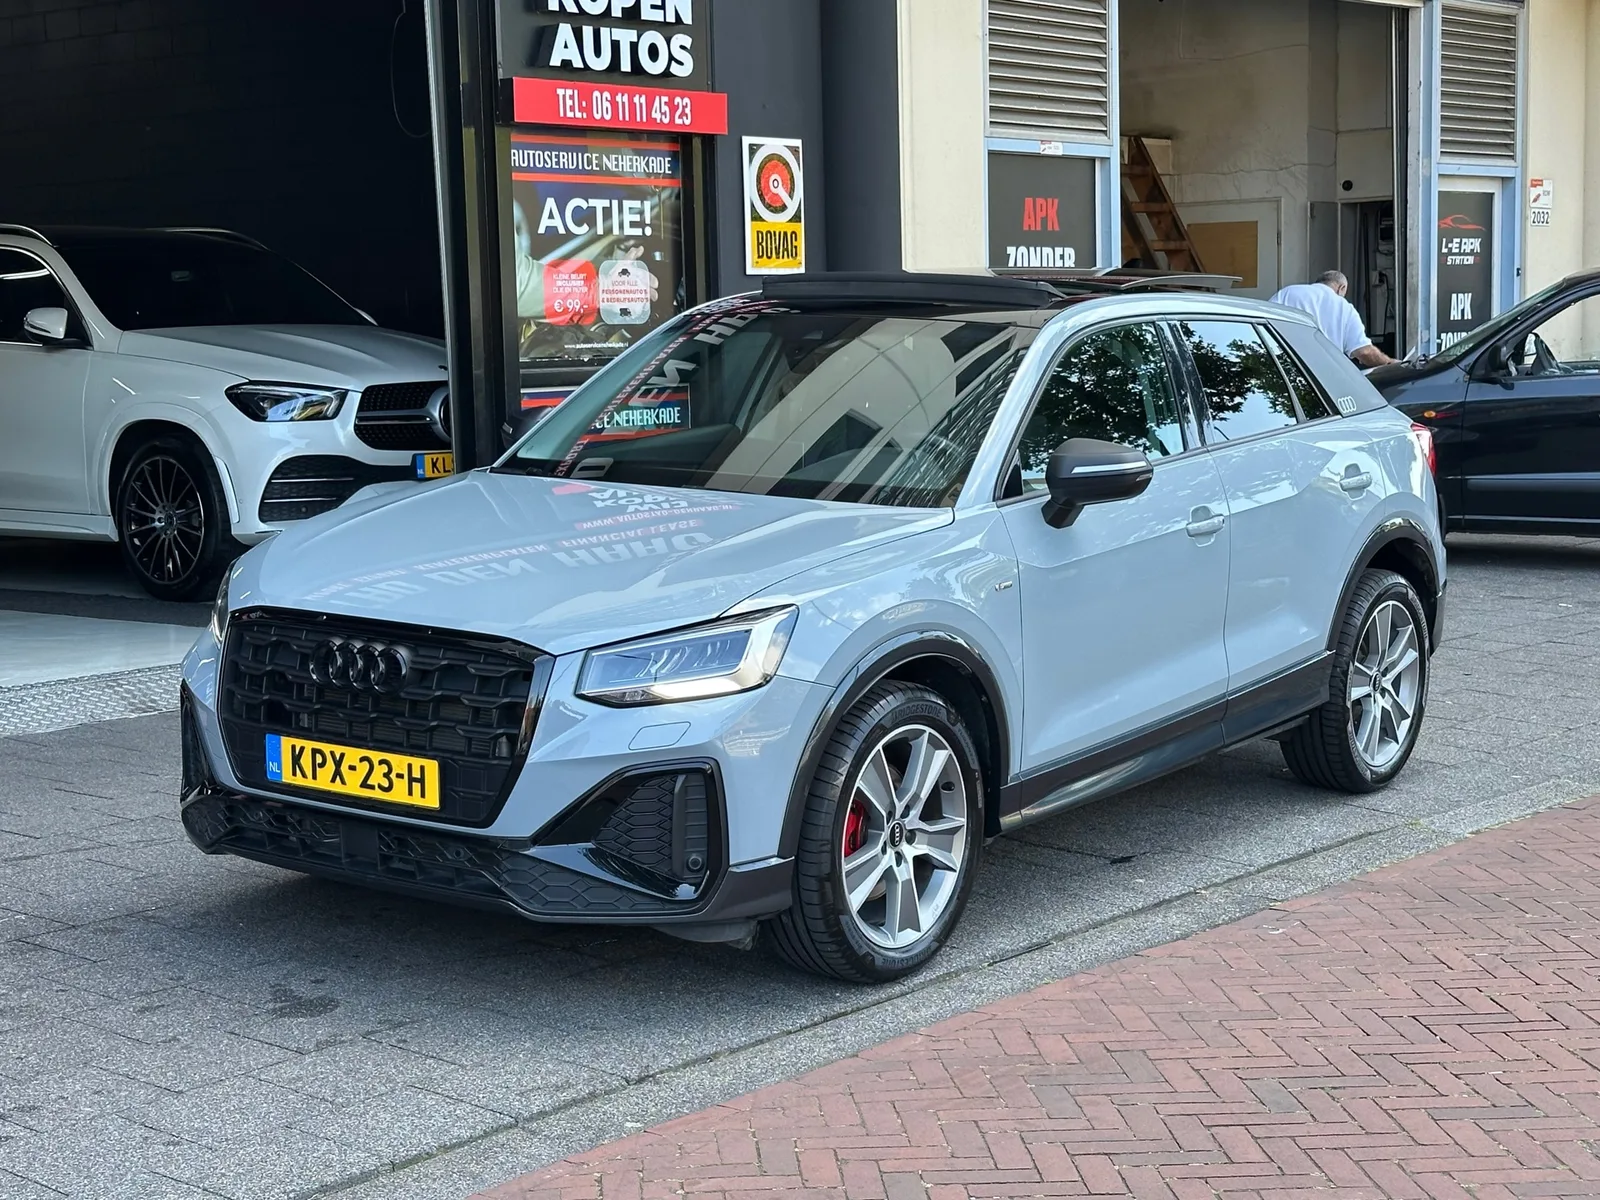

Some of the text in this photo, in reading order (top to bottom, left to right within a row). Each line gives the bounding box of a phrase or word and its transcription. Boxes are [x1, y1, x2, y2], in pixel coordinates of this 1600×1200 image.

[549, 23, 694, 77] AUTOS
[556, 88, 692, 125] TEL: 06 11 11 45 23
[511, 150, 672, 174] AUTOSERVICE NEHERKADE
[537, 197, 652, 237] ACTIE!
[1022, 197, 1060, 231] APK
[1531, 211, 1550, 224] 2032
[756, 230, 798, 260] BOVAG
[1006, 246, 1076, 268] ZONDER
[1461, 238, 1481, 253] APK
[1446, 255, 1474, 265] STATION
[554, 300, 563, 312] €
[1450, 293, 1472, 320] APK
[613, 407, 681, 428] NEHERKADE
[431, 456, 454, 474] KL
[269, 744, 427, 799] NL KPX-23-H
